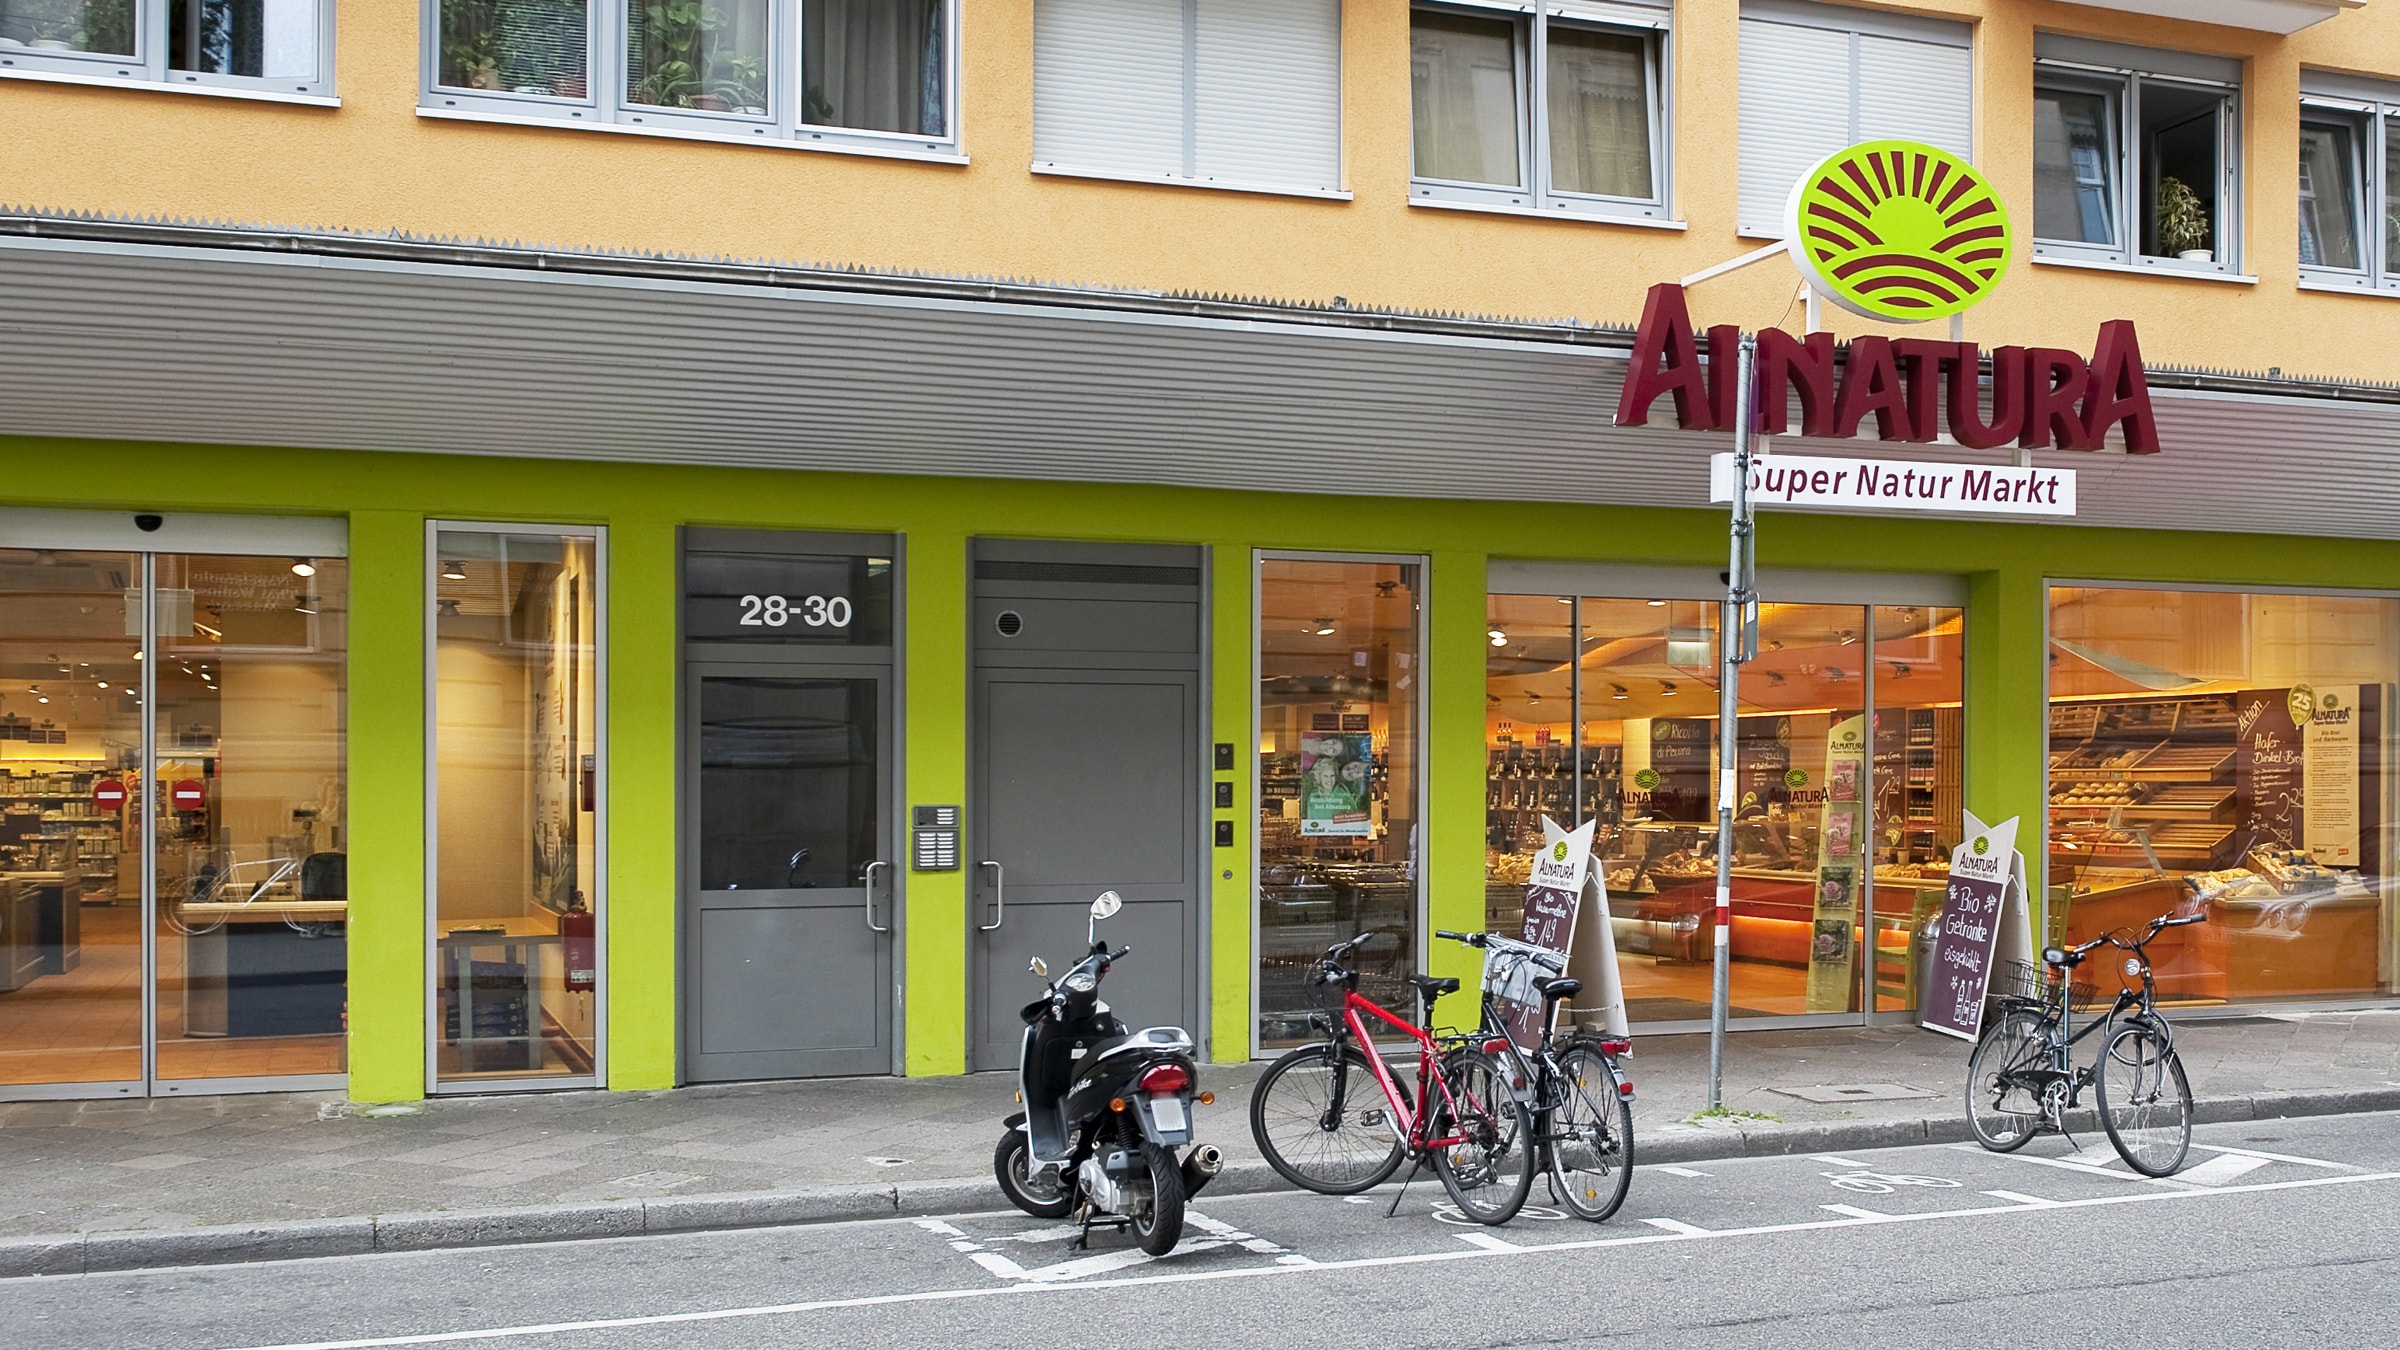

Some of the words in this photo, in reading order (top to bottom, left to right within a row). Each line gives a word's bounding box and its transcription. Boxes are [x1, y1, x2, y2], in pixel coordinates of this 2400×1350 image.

[1614, 283, 2160, 455] ALNATURA
[1856, 464, 1953, 500] Natur
[1961, 469, 2060, 505] Markt
[740, 595, 852, 627] 28-30
[2292, 693, 2311, 711] 25
[2238, 700, 2263, 732] Aktion
[2312, 707, 2350, 721] ALNATURA
[1618, 787, 1681, 803] ALNATURA
[1768, 787, 1829, 803] ALNATURA
[1539, 858, 1576, 880] ALNATURA
[1958, 851, 1998, 873] ALNATURA
[1958, 887, 1979, 914] Bio
